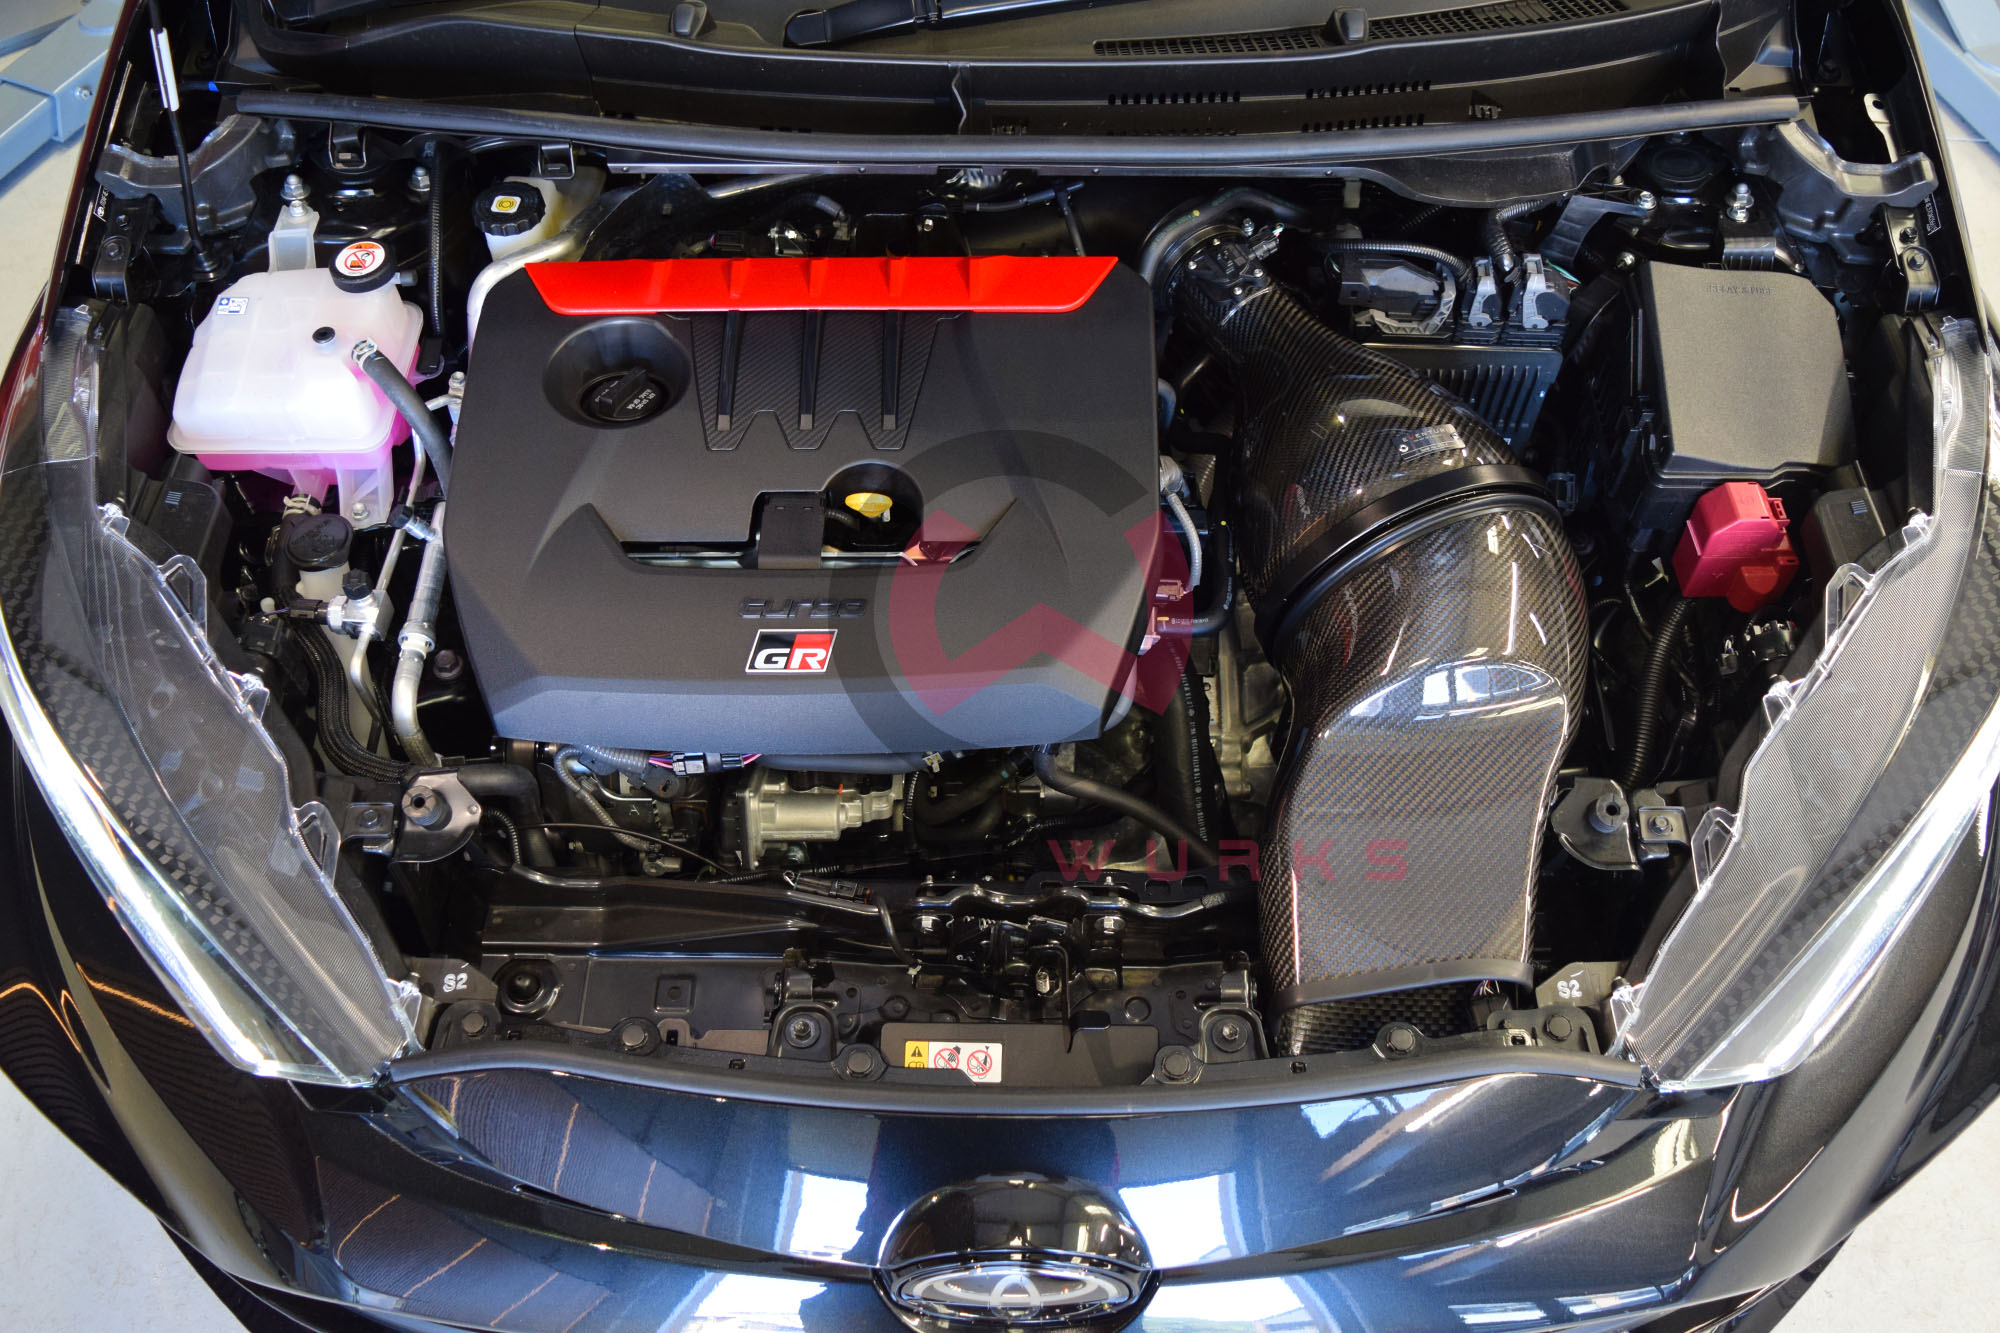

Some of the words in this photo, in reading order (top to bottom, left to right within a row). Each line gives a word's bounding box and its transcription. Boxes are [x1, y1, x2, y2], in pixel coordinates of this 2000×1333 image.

[754, 648, 827, 669] GR
[442, 972, 468, 993] S2
[1556, 979, 1583, 999] S2
